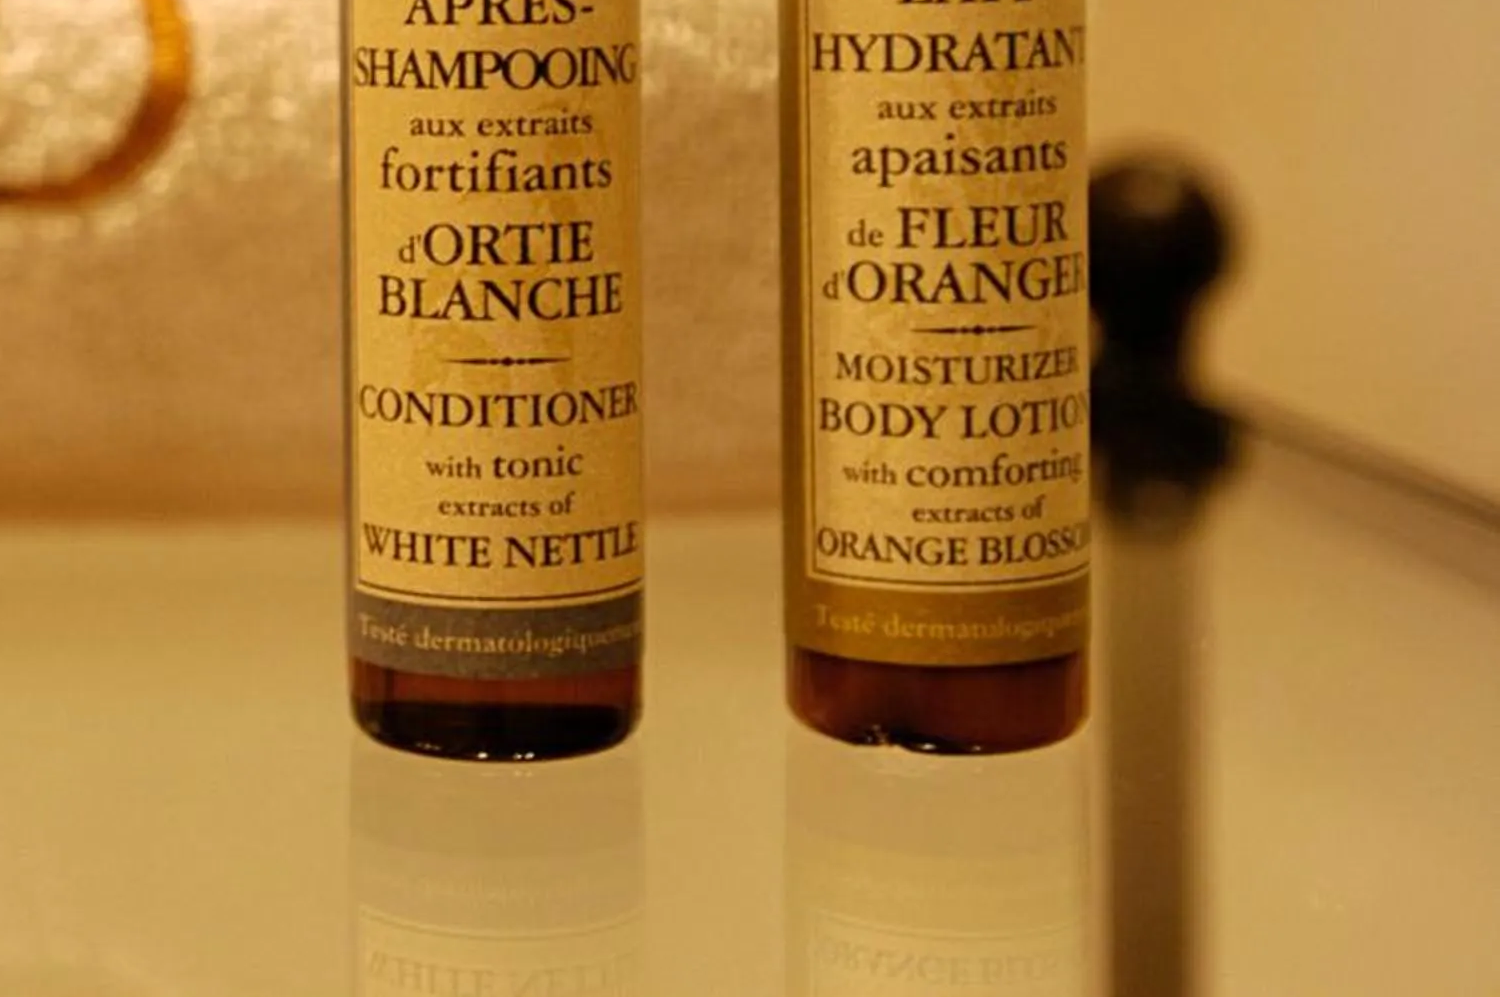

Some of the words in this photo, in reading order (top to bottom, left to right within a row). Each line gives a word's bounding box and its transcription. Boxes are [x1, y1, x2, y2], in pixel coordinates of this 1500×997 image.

[355, 43, 637, 91] SHAMPOOING
[410, 115, 465, 137] aux
[477, 107, 593, 137] extraits
[878, 99, 937, 121] aux
[949, 89, 1058, 121] extraits
[380, 146, 613, 193] fortifiants
[851, 131, 1068, 188] apaisants
[398, 220, 594, 267] d'ORTIE
[848, 219, 884, 249] de
[900, 200, 1069, 250] FLEUR
[378, 271, 623, 321] BLANCHE
[835, 345, 1080, 386] MOISTURIZER
[359, 381, 639, 428] CONDITIONER
[818, 397, 949, 440] BODY
[425, 454, 482, 480] with
[492, 445, 584, 480] tonic
[842, 461, 897, 486] with
[905, 447, 1083, 489] comforting
[438, 496, 541, 517] extracts
[548, 490, 577, 515] of
[912, 503, 1015, 524] extracts
[1021, 494, 1047, 518] of
[363, 521, 491, 569] WHITE
[503, 520, 640, 569] NETTLE
[817, 526, 968, 566] ORANGE
